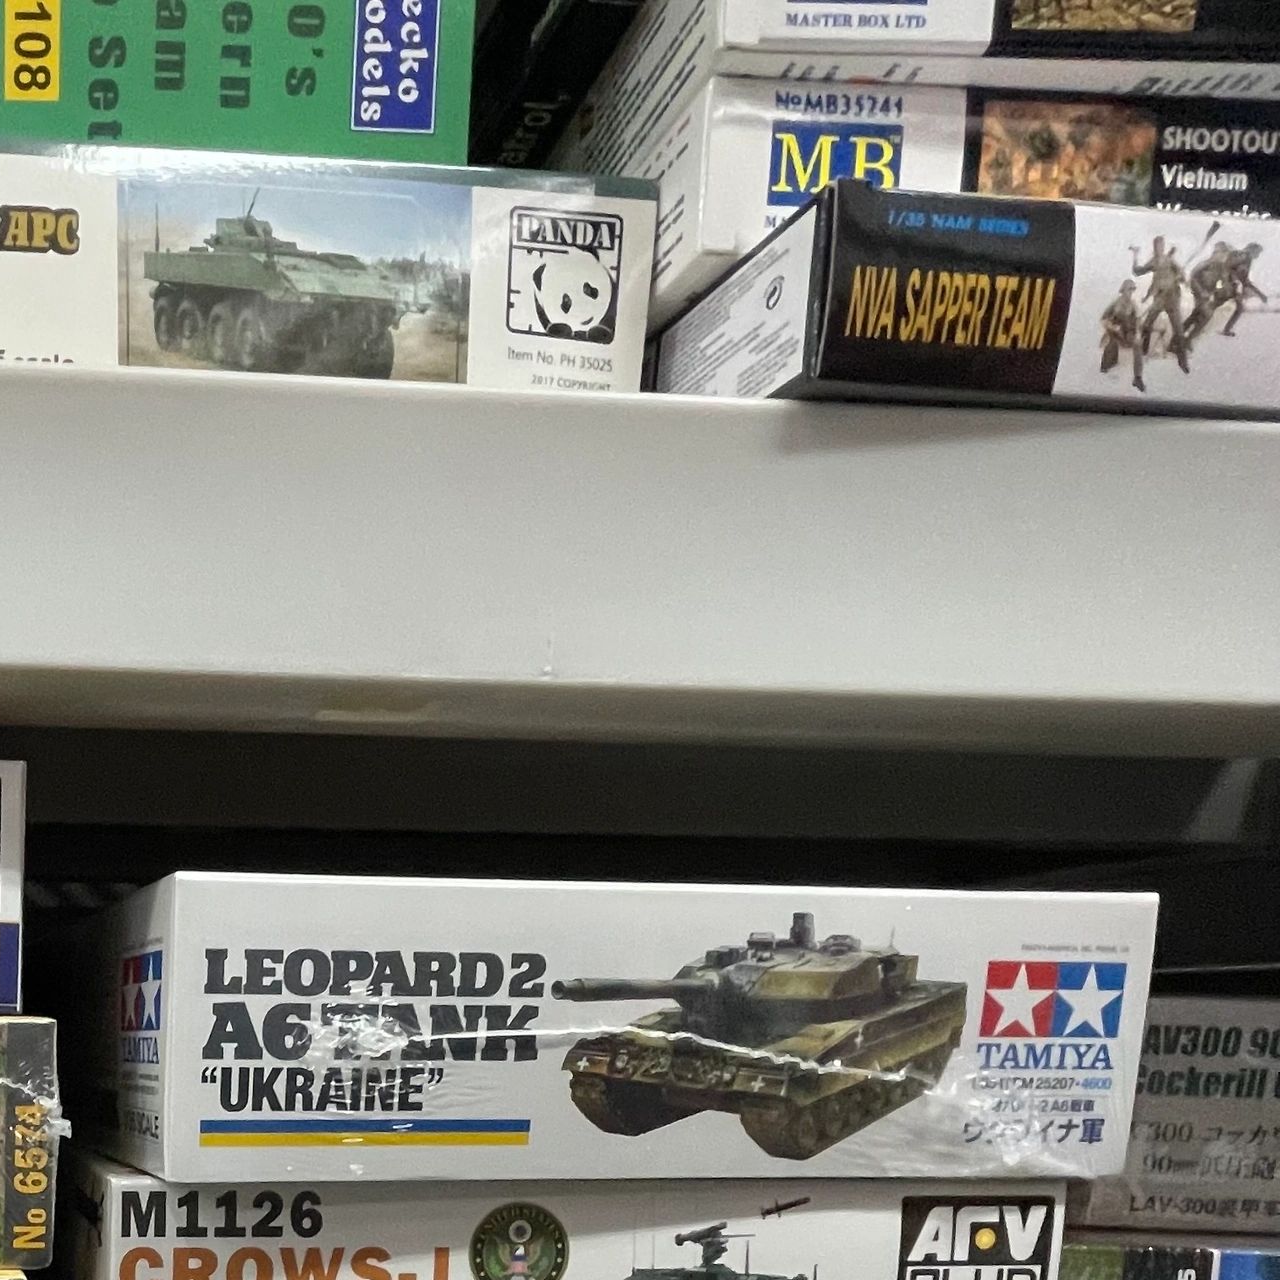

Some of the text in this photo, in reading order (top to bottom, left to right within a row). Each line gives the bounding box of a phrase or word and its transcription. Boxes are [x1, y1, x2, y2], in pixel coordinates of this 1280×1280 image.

[785, 11, 927, 30] MASTER BOX LTD
[1162, 125, 1280, 155] SHOOTOU
[1160, 163, 1249, 190] Vietnam
[1, 207, 80, 252] APC
[519, 215, 615, 250] PANDA
[845, 265, 894, 339] NVA
[898, 268, 989, 348] SAPPER
[986, 274, 1057, 350] TEAM
[507, 346, 613, 373] Item PH 35025
[203, 948, 505, 998] LEOPARD
[201, 1001, 313, 1061] A6
[976, 1042, 1115, 1070] TAMIYA
[12, 1208, 48, 1250] No
[120, 1189, 325, 1239] M1126
